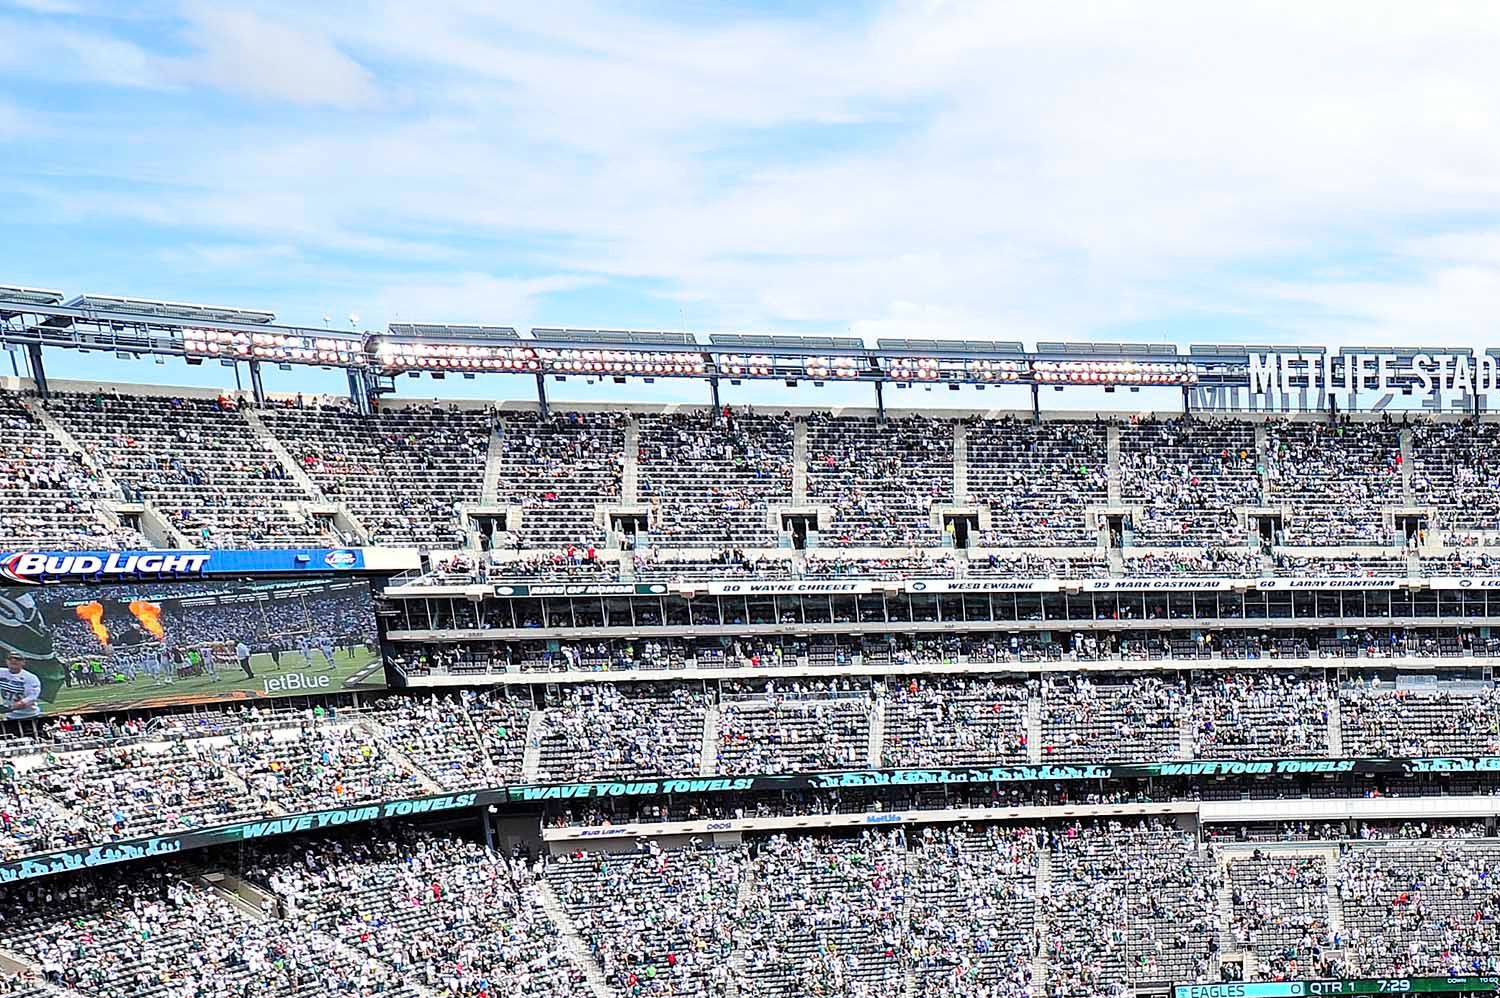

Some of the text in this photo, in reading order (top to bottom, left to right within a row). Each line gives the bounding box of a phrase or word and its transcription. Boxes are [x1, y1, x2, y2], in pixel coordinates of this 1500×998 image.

[1249, 353, 1397, 394] METLIFE
[18, 553, 210, 577] BUD LIGHT
[566, 585, 585, 595] OF
[750, 583, 798, 591] WAYNE
[1115, 581, 1151, 589] MARK
[263, 673, 330, 695] jetBlue
[1160, 760, 1356, 776] WAVE YOUR TOWELS!
[524, 779, 755, 801] WAVE YOUR TOWELS!
[243, 794, 477, 838] WAVE YOUR TOWELS!
[867, 813, 902, 823] MetLife
[1191, 984, 1301, 998] EAGLES 0
[1309, 979, 1411, 995] QTR 1 7:29
